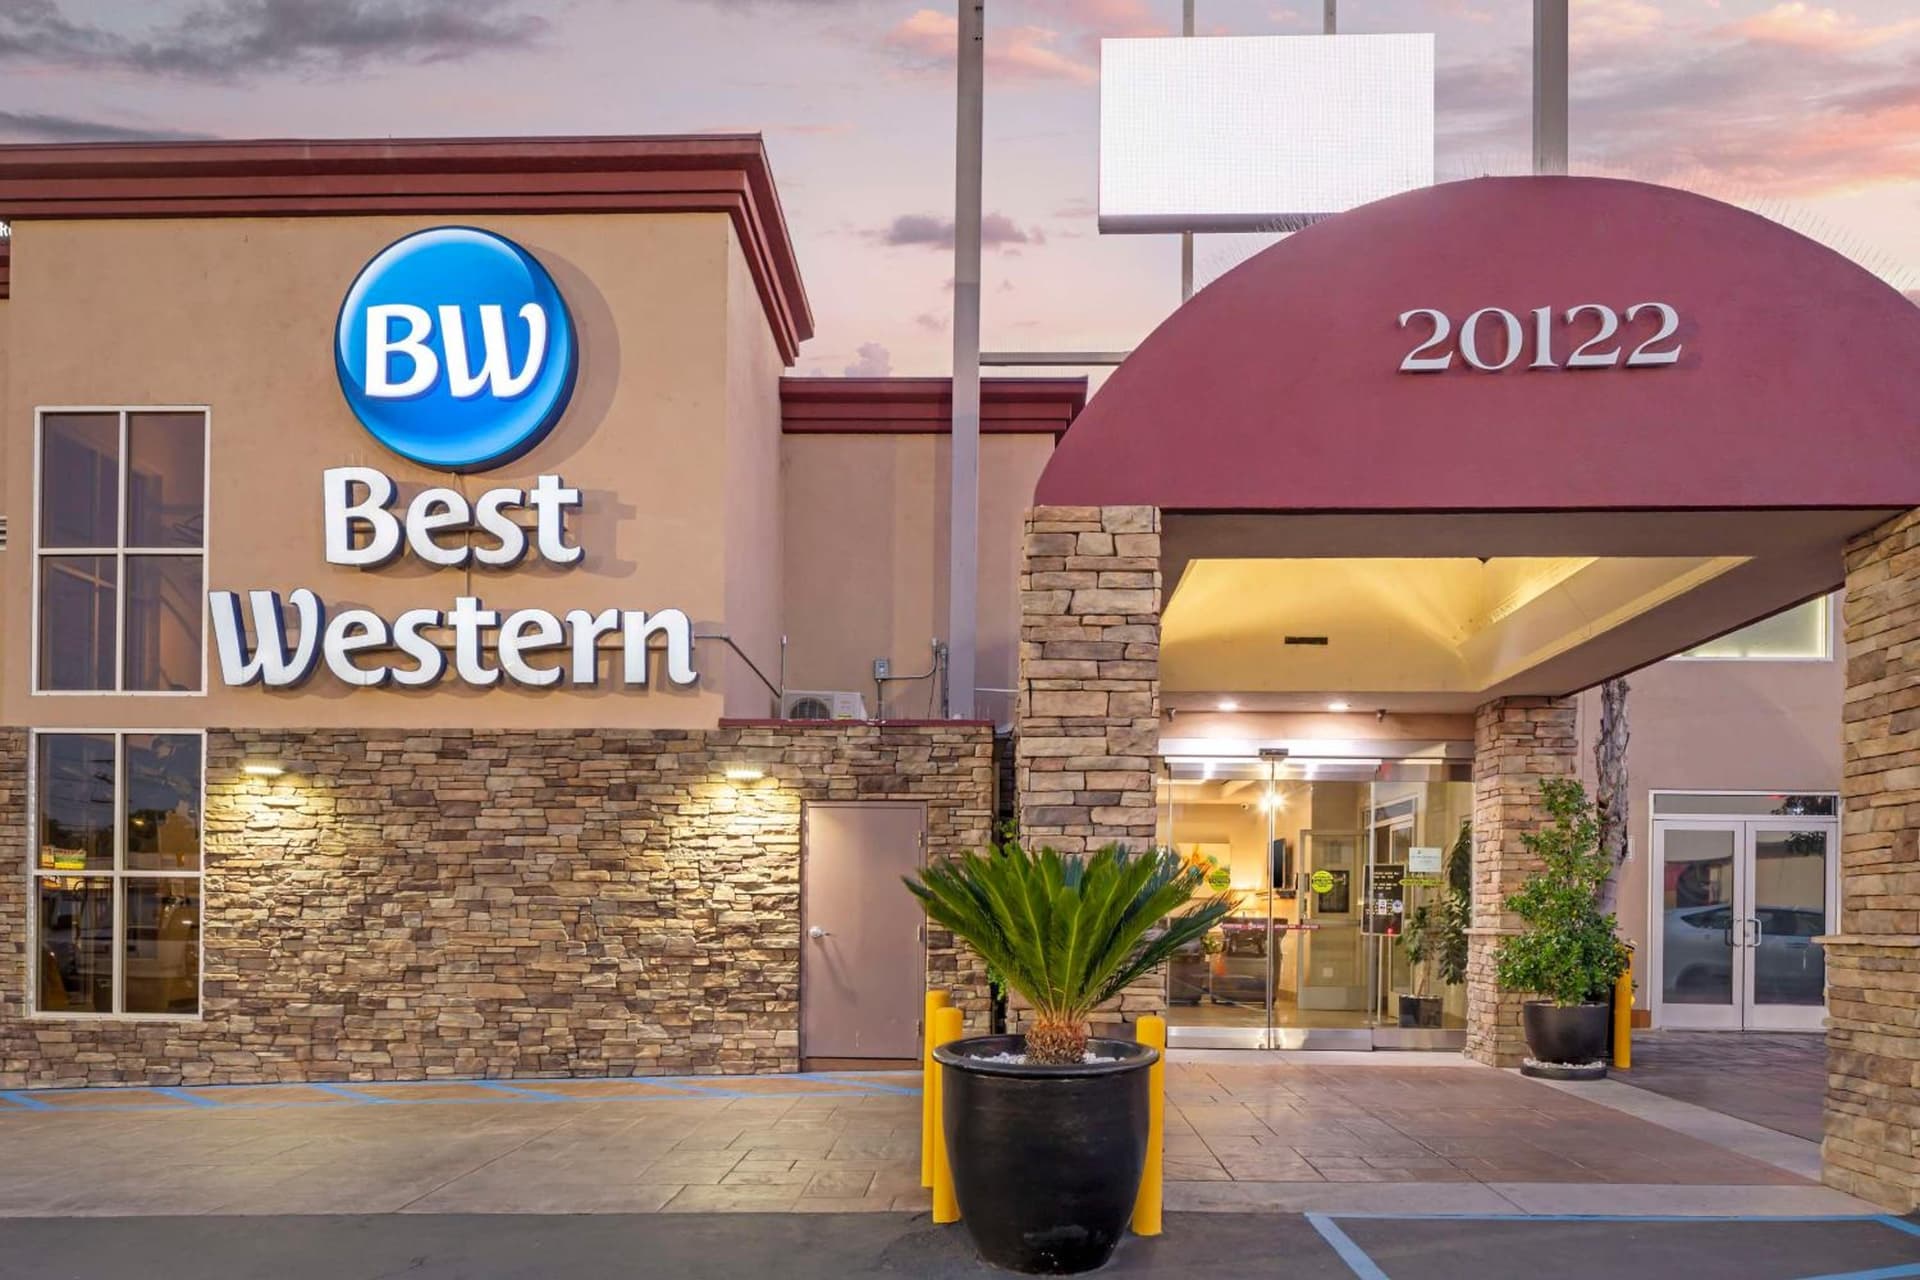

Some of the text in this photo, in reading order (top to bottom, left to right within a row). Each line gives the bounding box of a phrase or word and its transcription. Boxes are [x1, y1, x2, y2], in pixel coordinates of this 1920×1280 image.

[364, 302, 547, 399] BW
[1398, 302, 1683, 370] 20122
[322, 466, 584, 567] Best
[208, 588, 698, 688] Western
